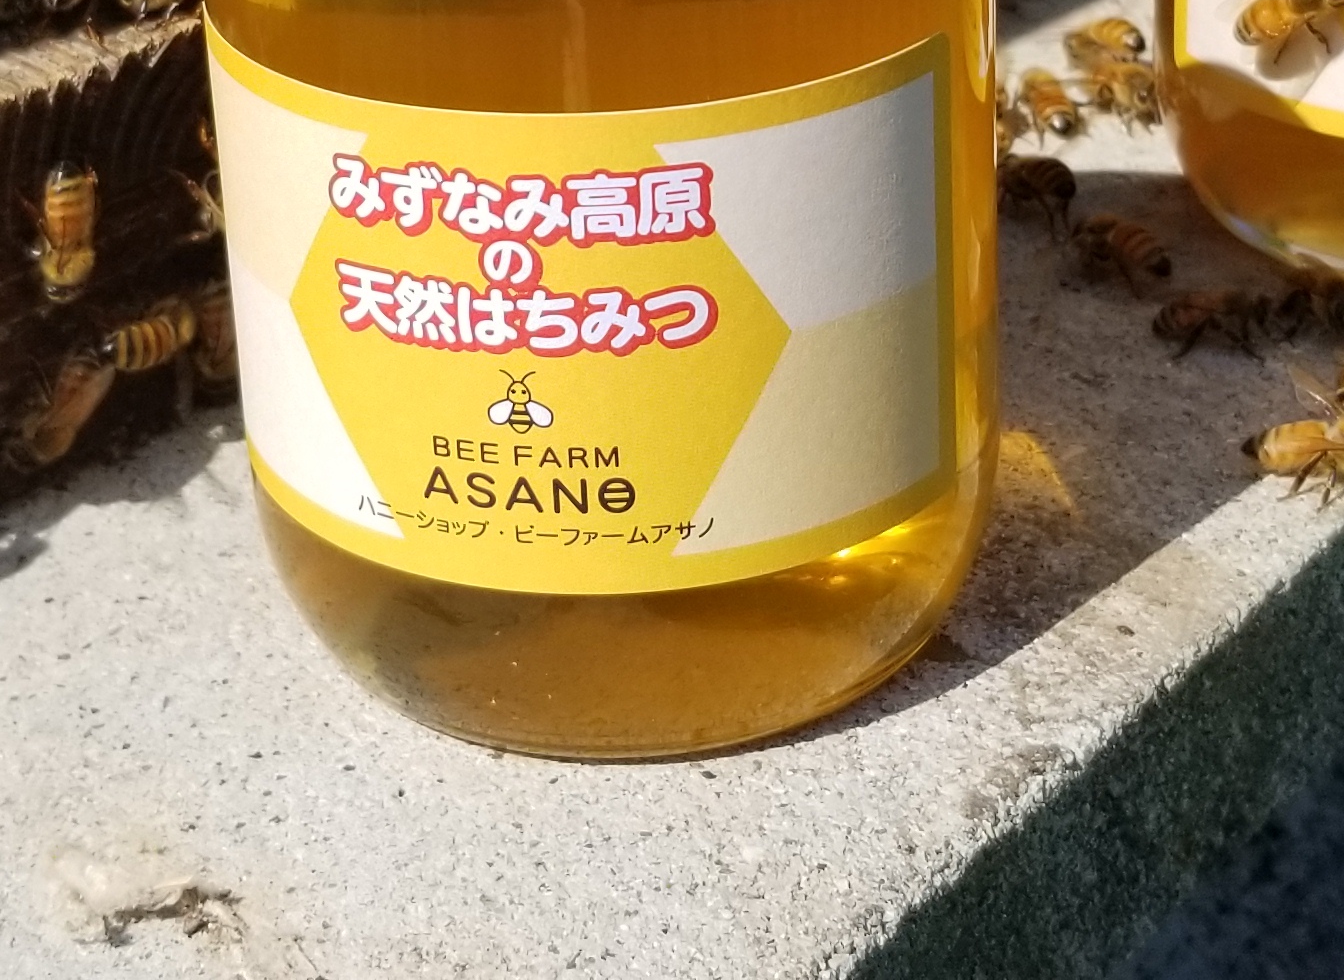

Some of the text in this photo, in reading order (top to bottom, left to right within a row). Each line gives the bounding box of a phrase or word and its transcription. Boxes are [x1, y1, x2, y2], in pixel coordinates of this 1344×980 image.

[329, 153, 715, 246] みずなみ高原
[481, 236, 540, 285] の
[335, 259, 718, 357] 天然はちみつ
[432, 435, 621, 469] BEE FARM
[424, 466, 636, 515] ASANO
